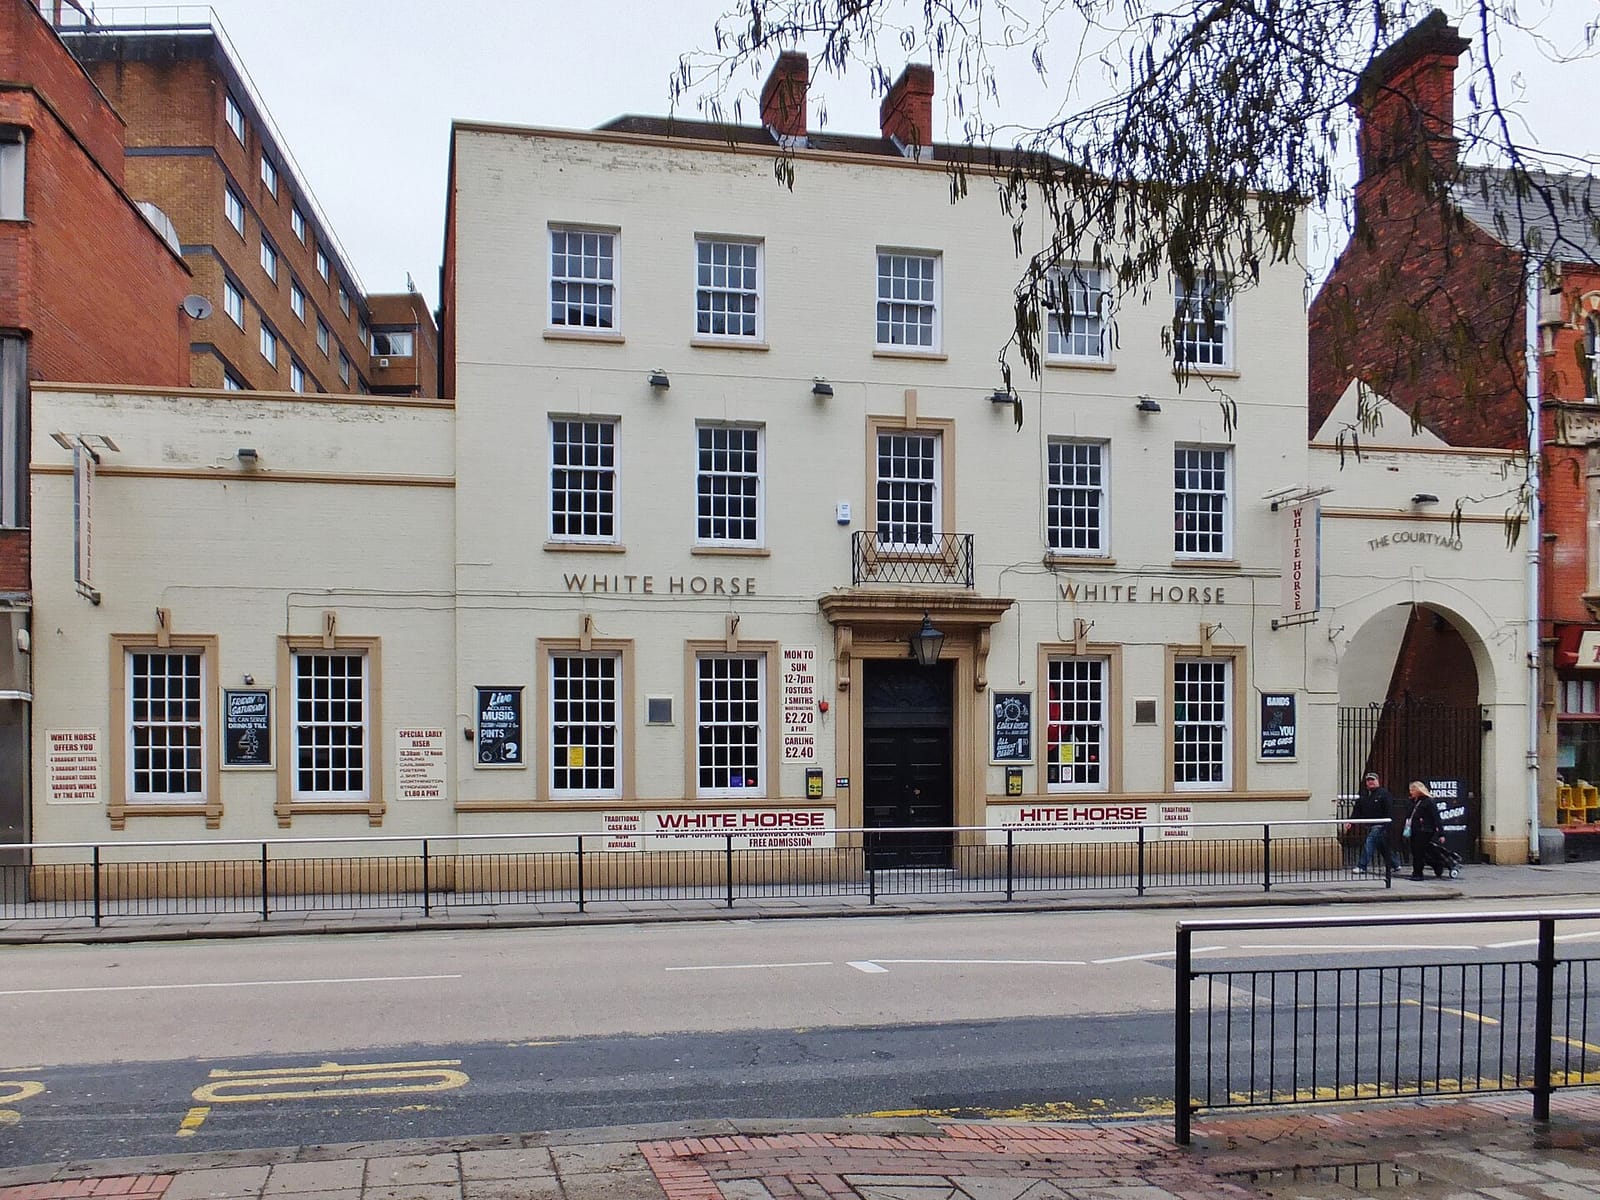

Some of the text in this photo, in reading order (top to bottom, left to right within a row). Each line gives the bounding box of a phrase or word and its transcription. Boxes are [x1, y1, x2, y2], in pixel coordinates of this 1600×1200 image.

[1368, 532, 1463, 551] THE COURTYARD
[1293, 508, 1302, 610] WHITE HORSE
[563, 573, 756, 594] WHITE HORSE
[1059, 584, 1225, 604] WHITE HORSE
[784, 650, 814, 659] MON TO
[791, 663, 807, 671] SUN
[784, 674, 814, 684] 12-7pm
[785, 686, 813, 694] FOSTERS
[489, 692, 512, 706] Live
[1266, 697, 1290, 706] BANDS
[482, 711, 514, 720] MUSIC
[784, 712, 814, 723] £2.20
[480, 729, 505, 738] PINTS
[1279, 726, 1294, 736] YOU
[784, 737, 814, 745] CARLING
[1262, 739, 1276, 748] FOR
[785, 747, 814, 758] £2.40
[1430, 781, 1458, 789] WHITE
[1430, 789, 1458, 798] HORSE
[1073, 807, 1147, 820] HORSE
[656, 813, 825, 828] WHITE HORSE
[607, 823, 637, 831] CASK ALES
[749, 837, 812, 847] FREE ADMISSION
